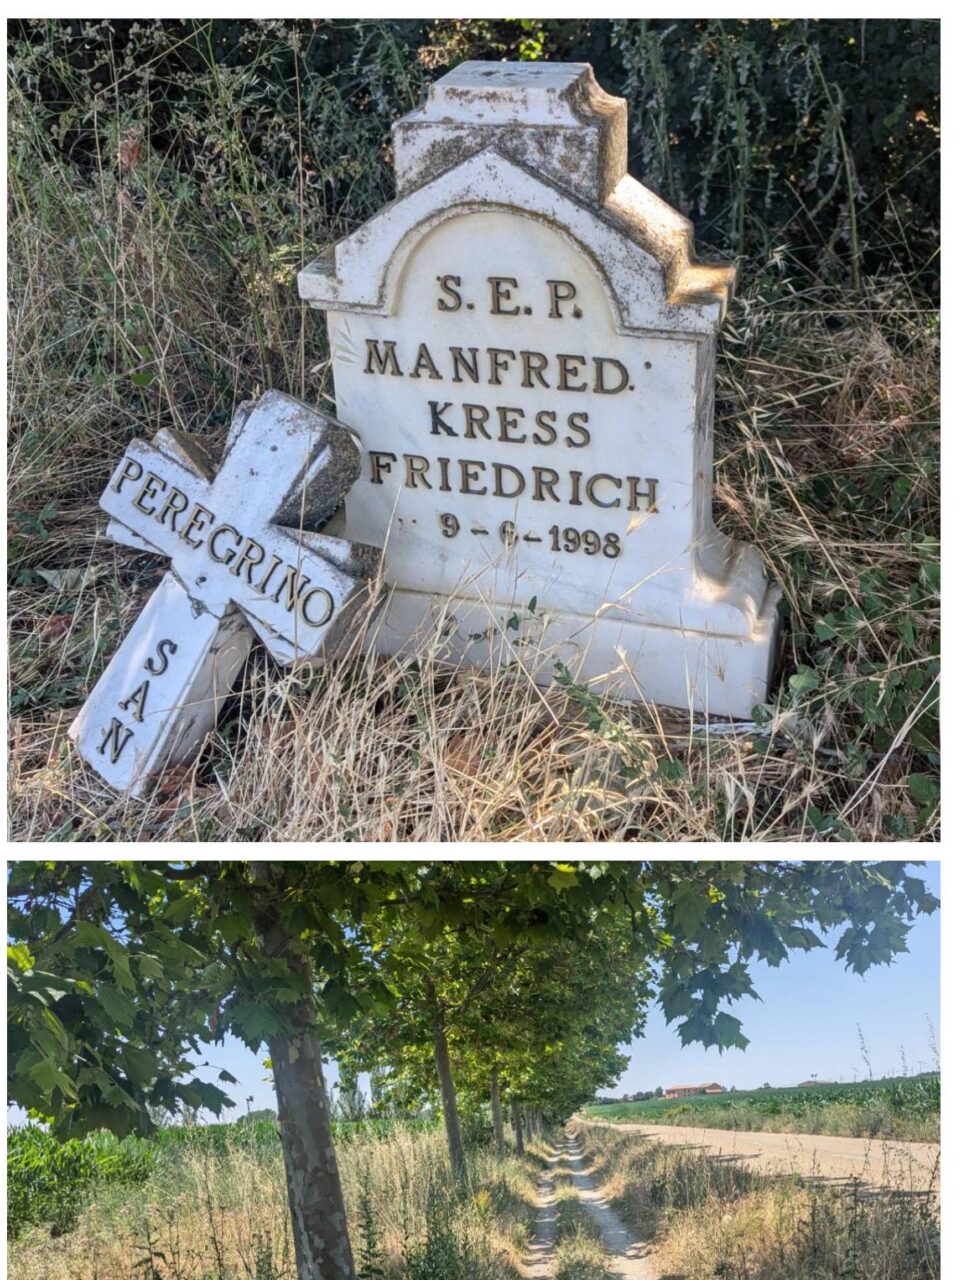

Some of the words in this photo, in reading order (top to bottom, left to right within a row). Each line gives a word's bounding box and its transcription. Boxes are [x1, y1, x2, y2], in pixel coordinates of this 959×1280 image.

[428, 401, 591, 448] KRESS
[369, 452, 659, 513] FRIEDRICH
[110, 456, 336, 627] PEREGRINO
[96, 638, 178, 763] SAN
